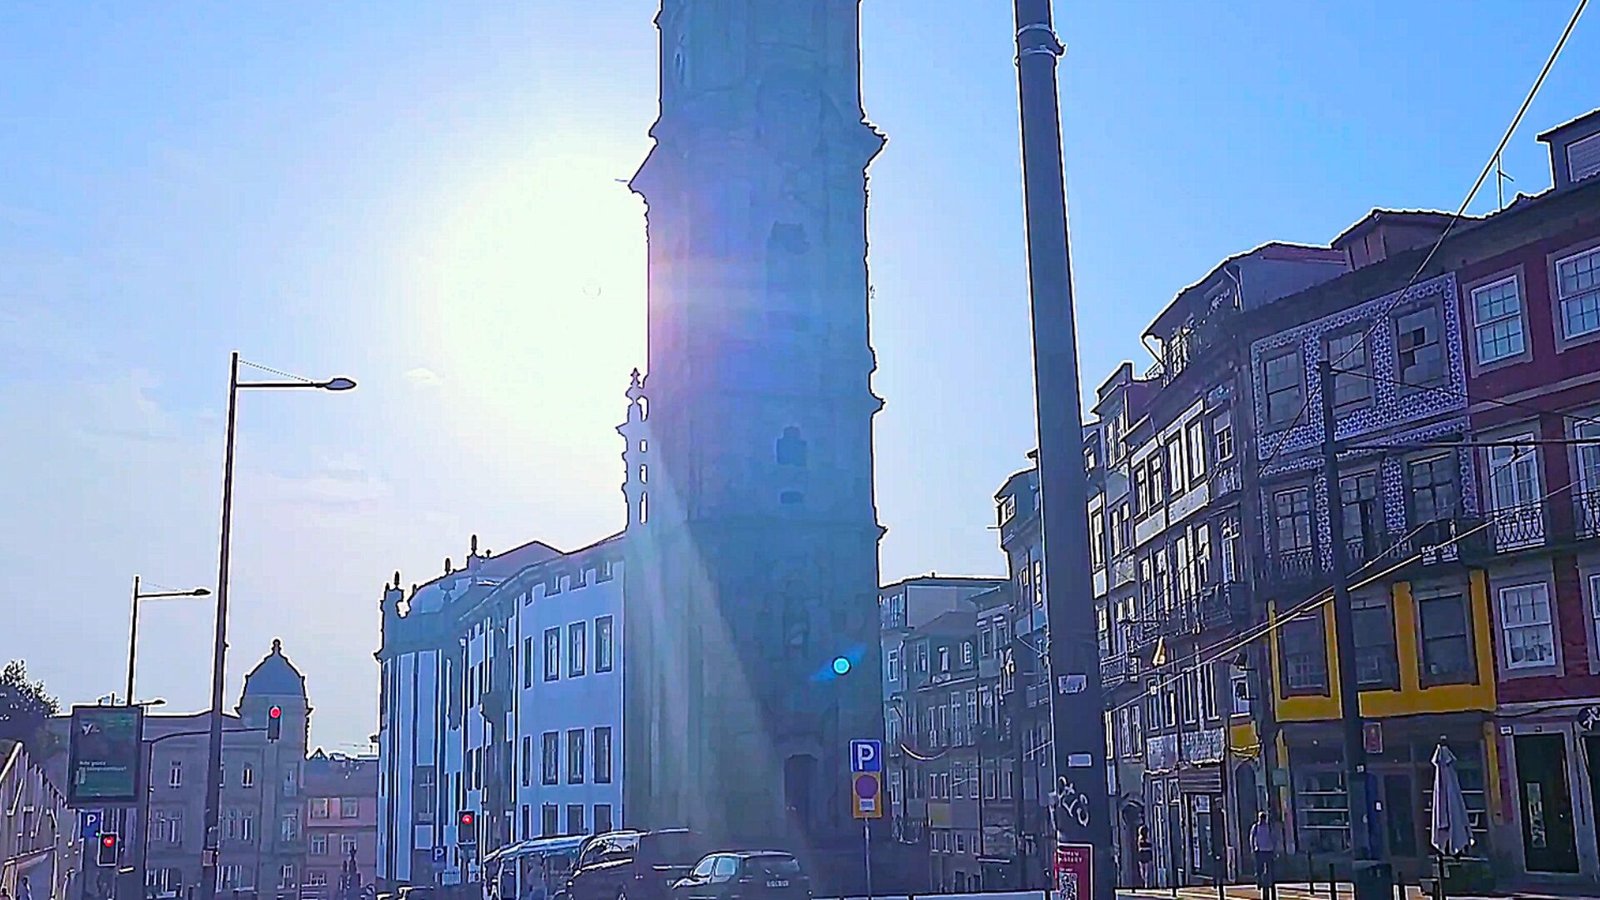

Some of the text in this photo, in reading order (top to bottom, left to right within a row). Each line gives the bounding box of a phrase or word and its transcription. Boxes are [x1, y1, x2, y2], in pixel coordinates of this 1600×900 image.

[857, 744, 875, 770] P
[86, 814, 97, 827] P
[434, 844, 445, 861] P
